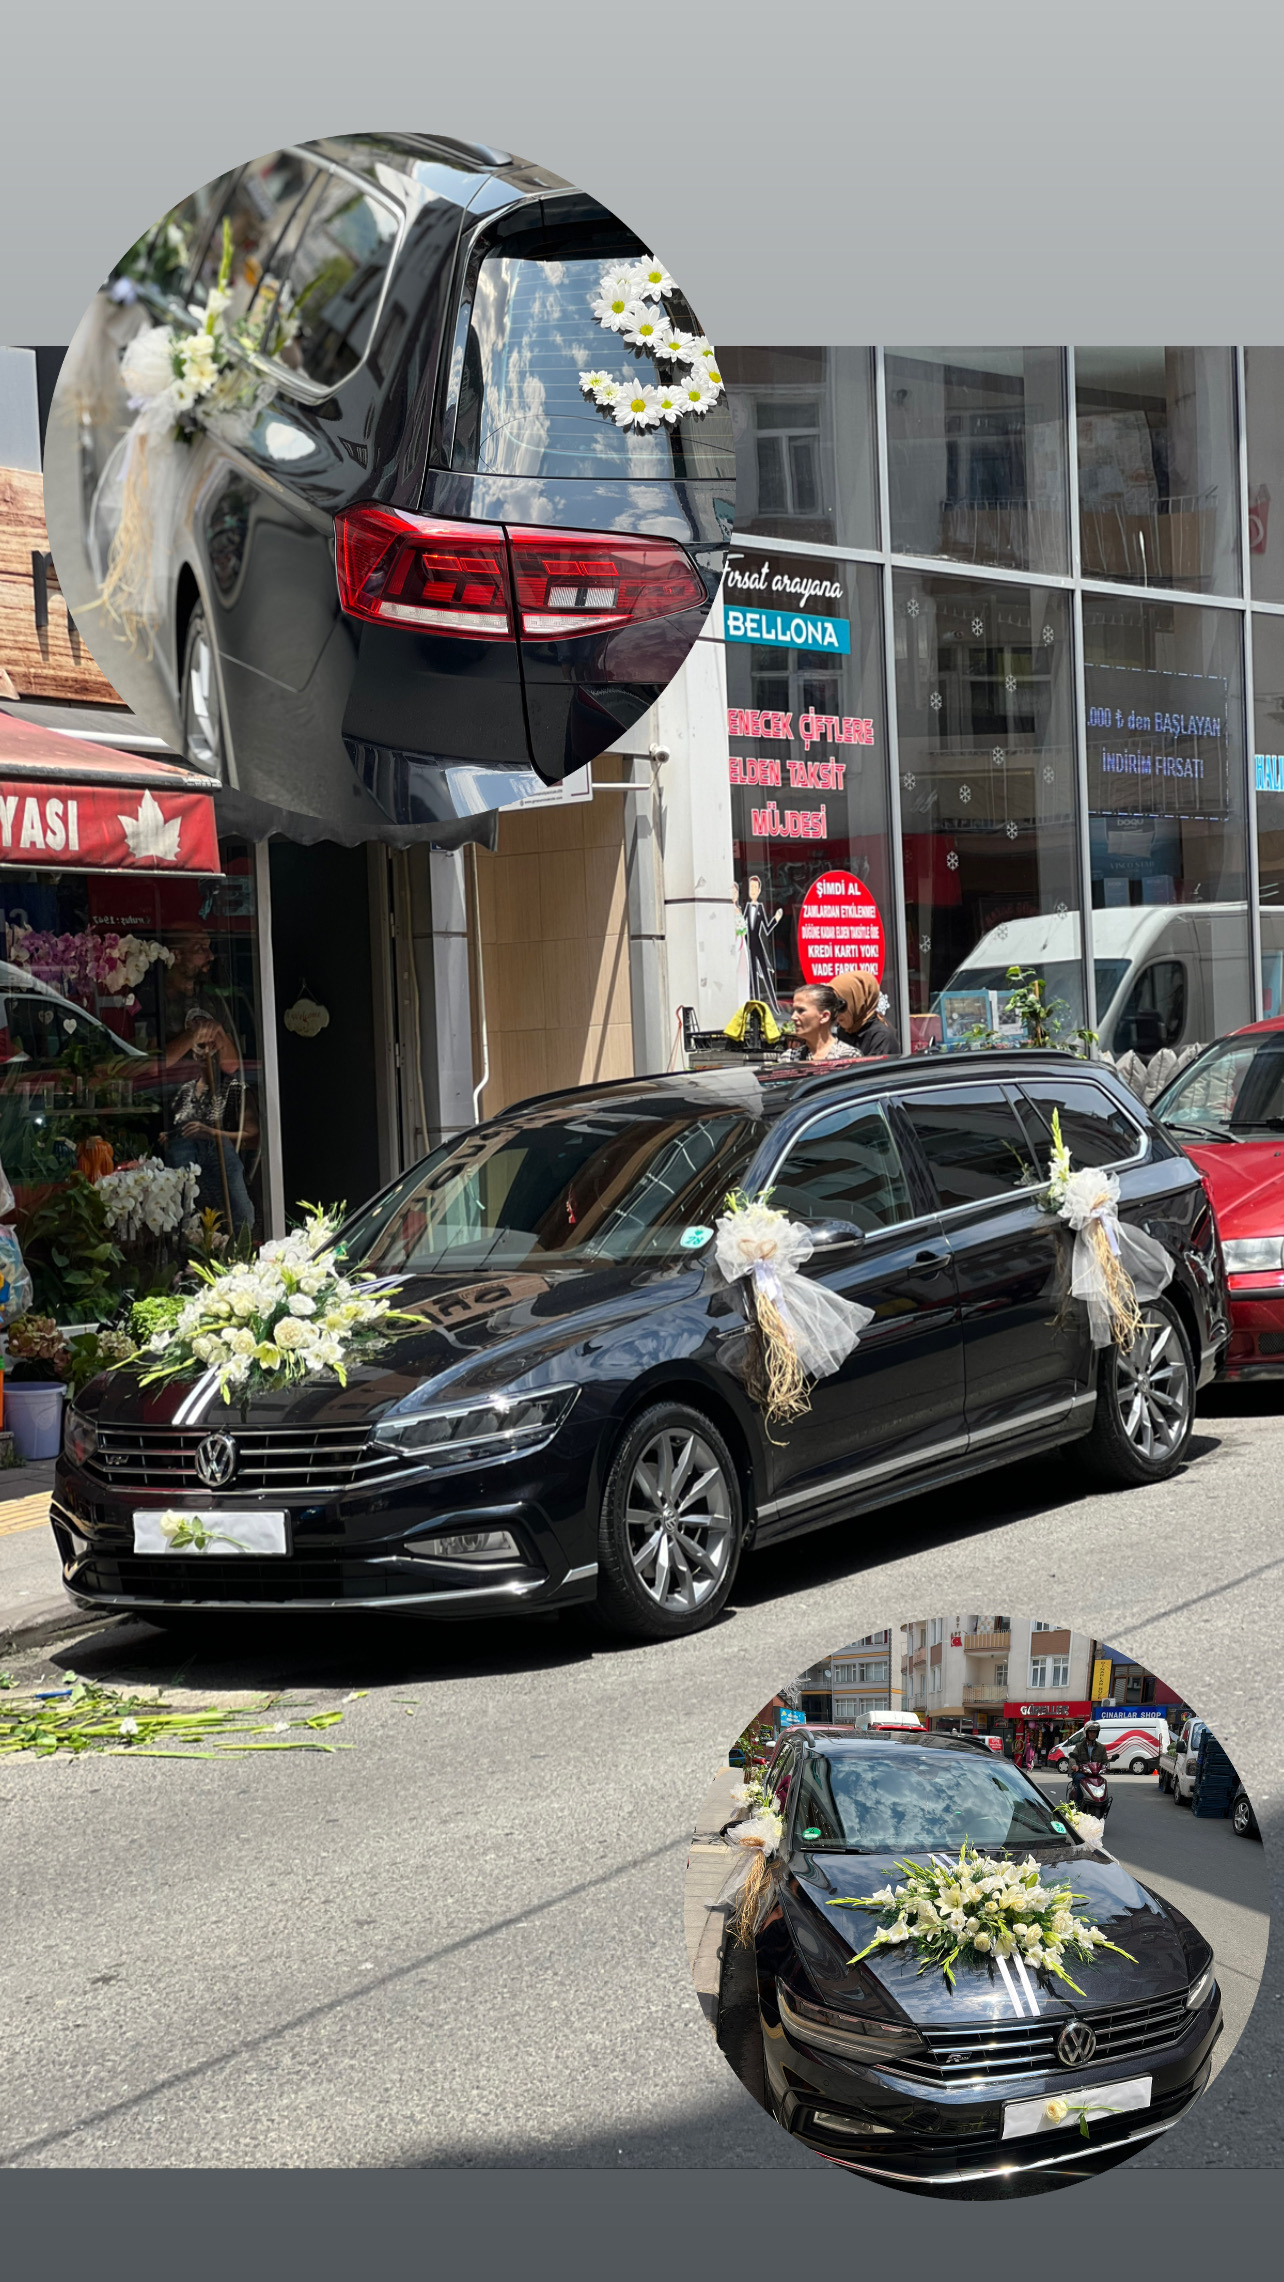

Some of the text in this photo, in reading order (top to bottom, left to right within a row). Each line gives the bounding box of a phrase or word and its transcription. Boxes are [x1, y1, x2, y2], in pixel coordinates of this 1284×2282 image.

[771, 574, 844, 608] arayana
[727, 610, 839, 648] BELLONA
[799, 706, 875, 751] ÇİFTLERE
[1128, 710, 1151, 731] den
[1154, 711, 1222, 739] BAŞLAYAN
[728, 756, 846, 790] ELDEN TAKSİT
[1102, 746, 1205, 779] İNDİRİM FIRSATI
[751, 801, 828, 839] MÜJDESİ
[816, 879, 861, 898] ŞİMDİ AL
[803, 905, 840, 918] ZAMLARDAN
[808, 942, 879, 958] KREDİ KARTI YOK!
[811, 962, 834, 976] VADE
[1101, 1711, 1162, 1719] ÇINARLAR SHOP
